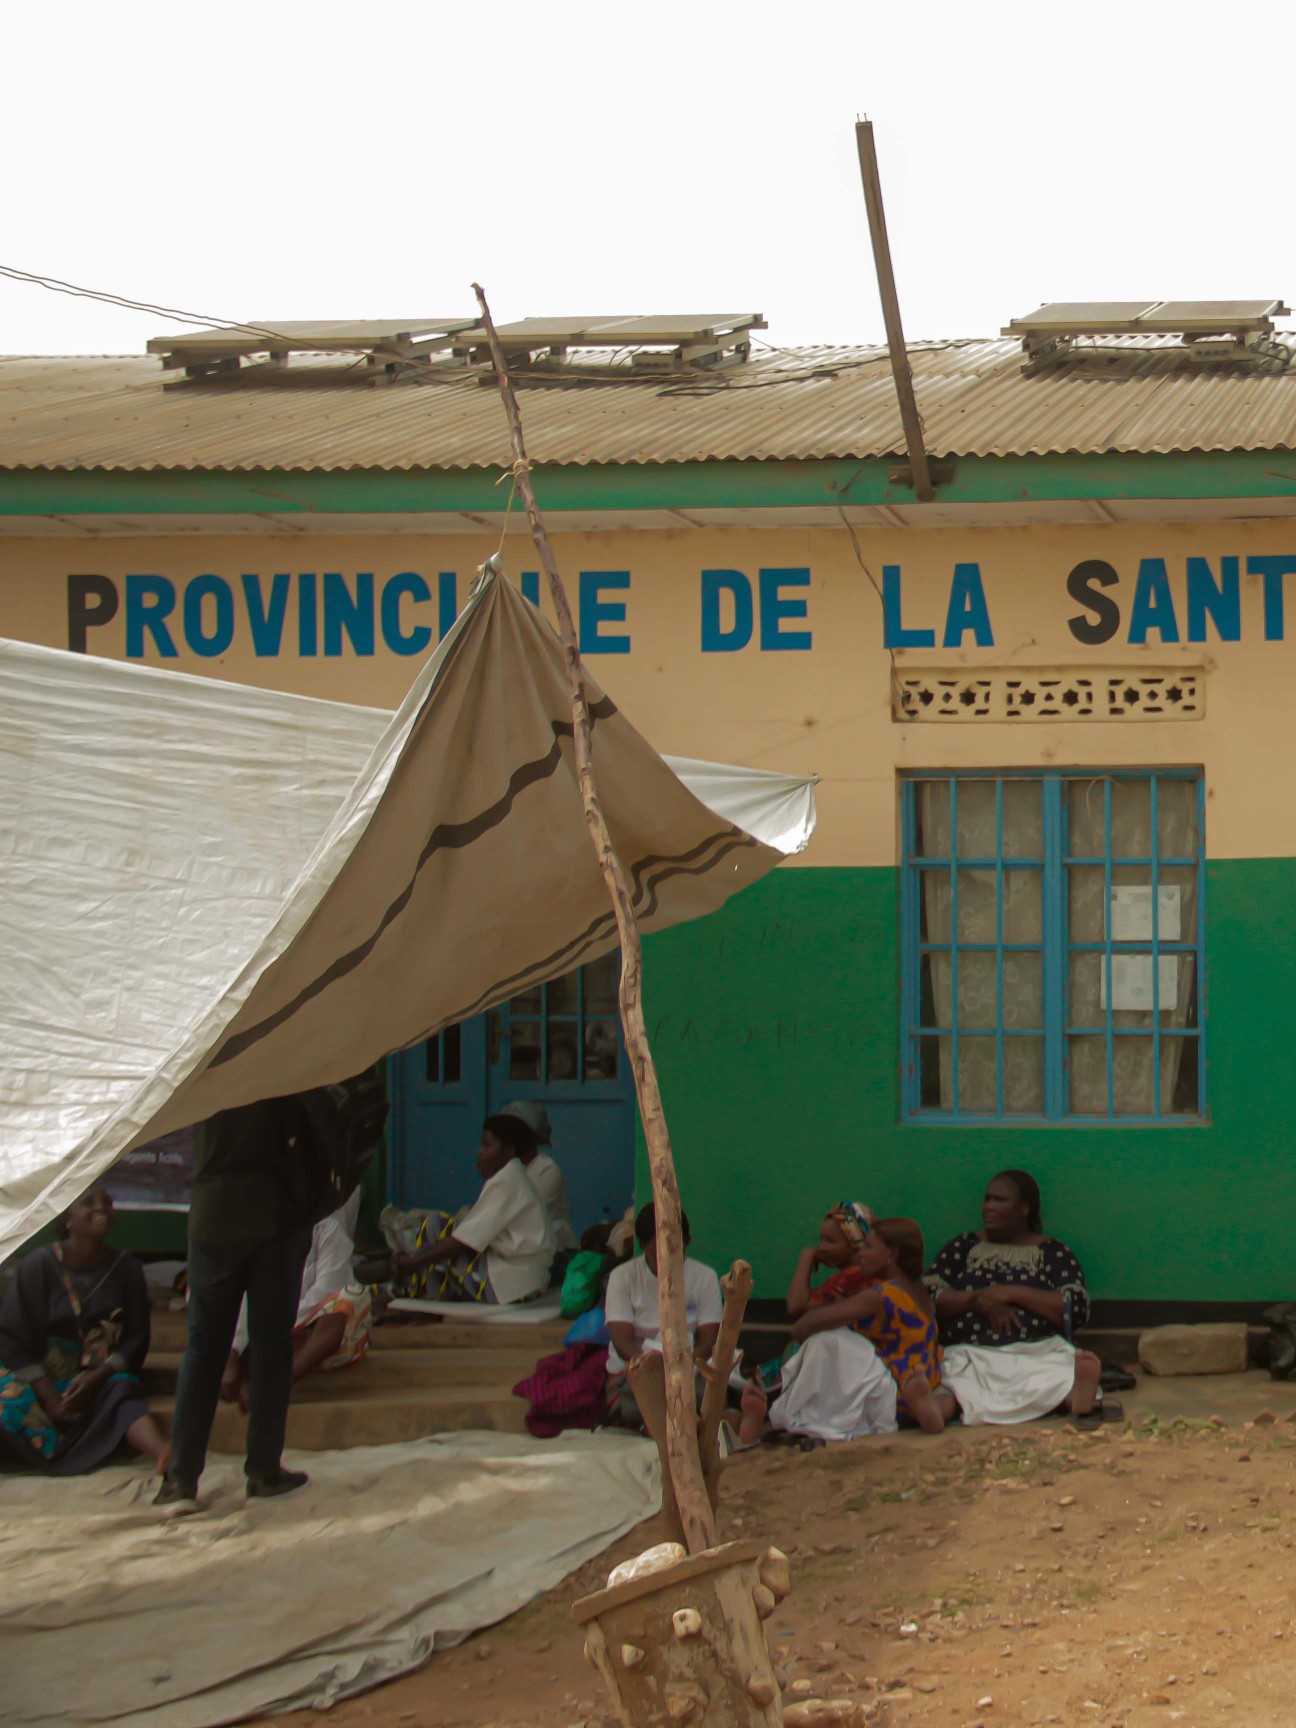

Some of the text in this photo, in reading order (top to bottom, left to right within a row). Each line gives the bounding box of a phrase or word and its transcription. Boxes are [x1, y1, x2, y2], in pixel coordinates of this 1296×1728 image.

[67, 571, 631, 657] PROVINCIE
[701, 567, 812, 653] DE
[881, 563, 995, 649] LA
